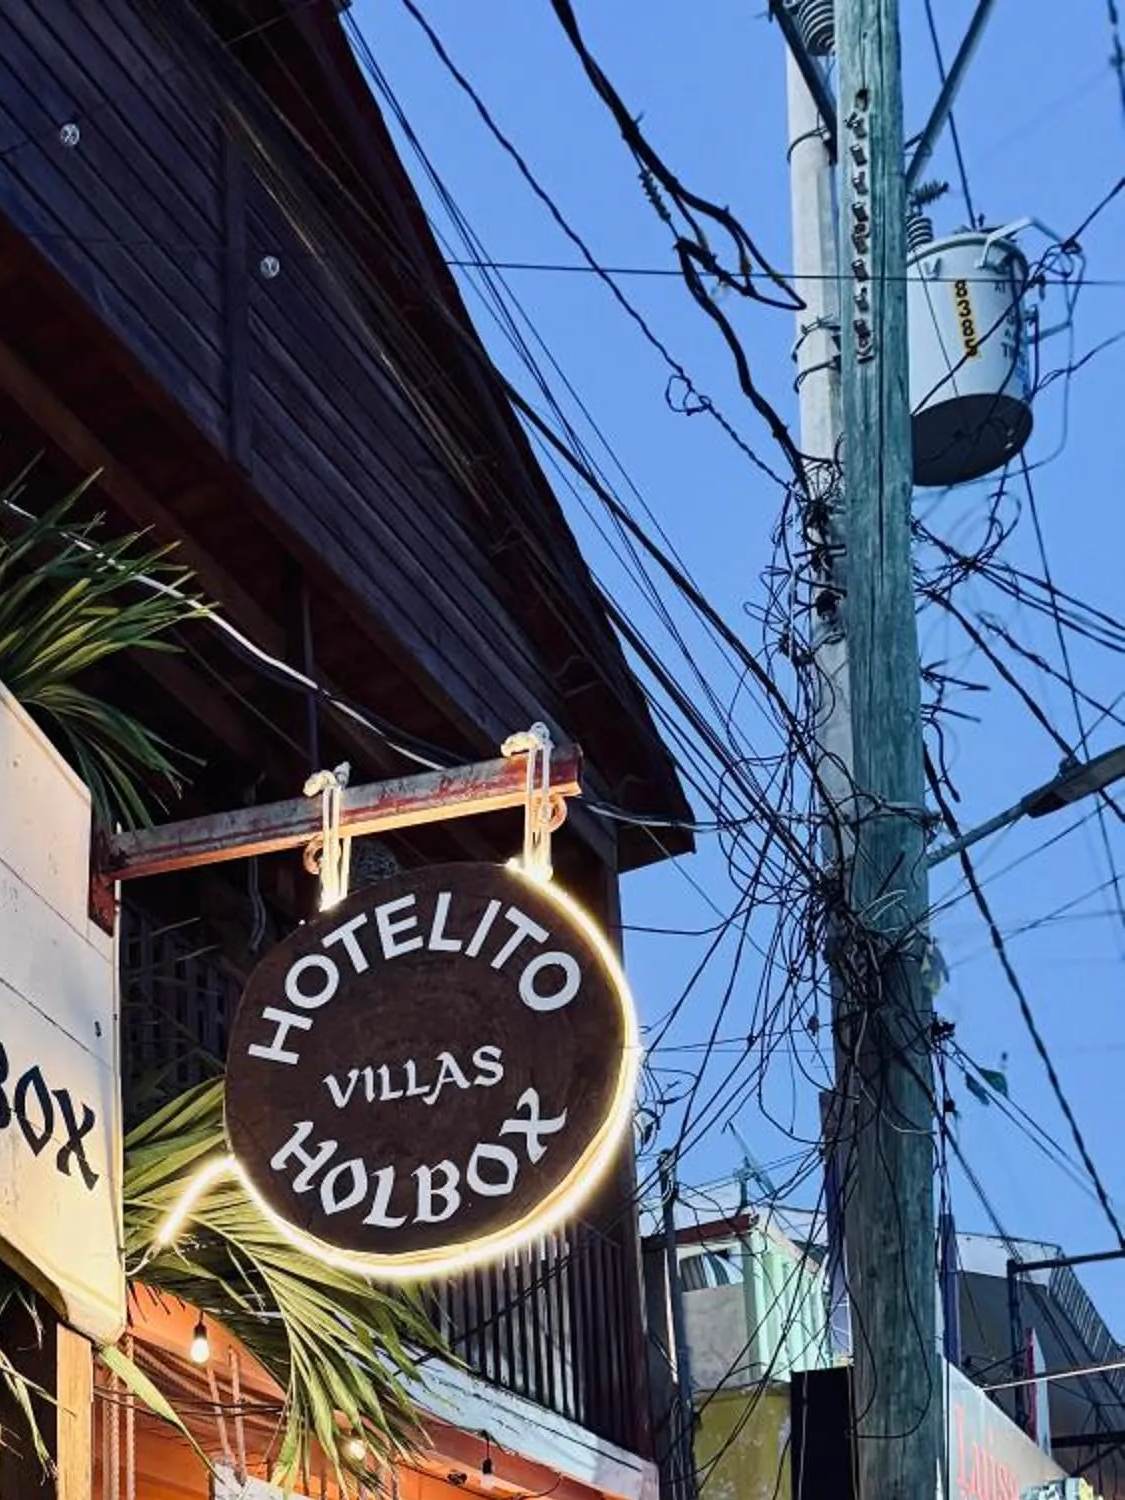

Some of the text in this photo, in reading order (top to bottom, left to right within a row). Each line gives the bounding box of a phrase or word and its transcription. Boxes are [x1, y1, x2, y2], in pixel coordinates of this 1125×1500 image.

[248, 891, 582, 1065] HOTELITO
[323, 1045, 504, 1108] VILLAS
[270, 1087, 568, 1228] HOLBOX
